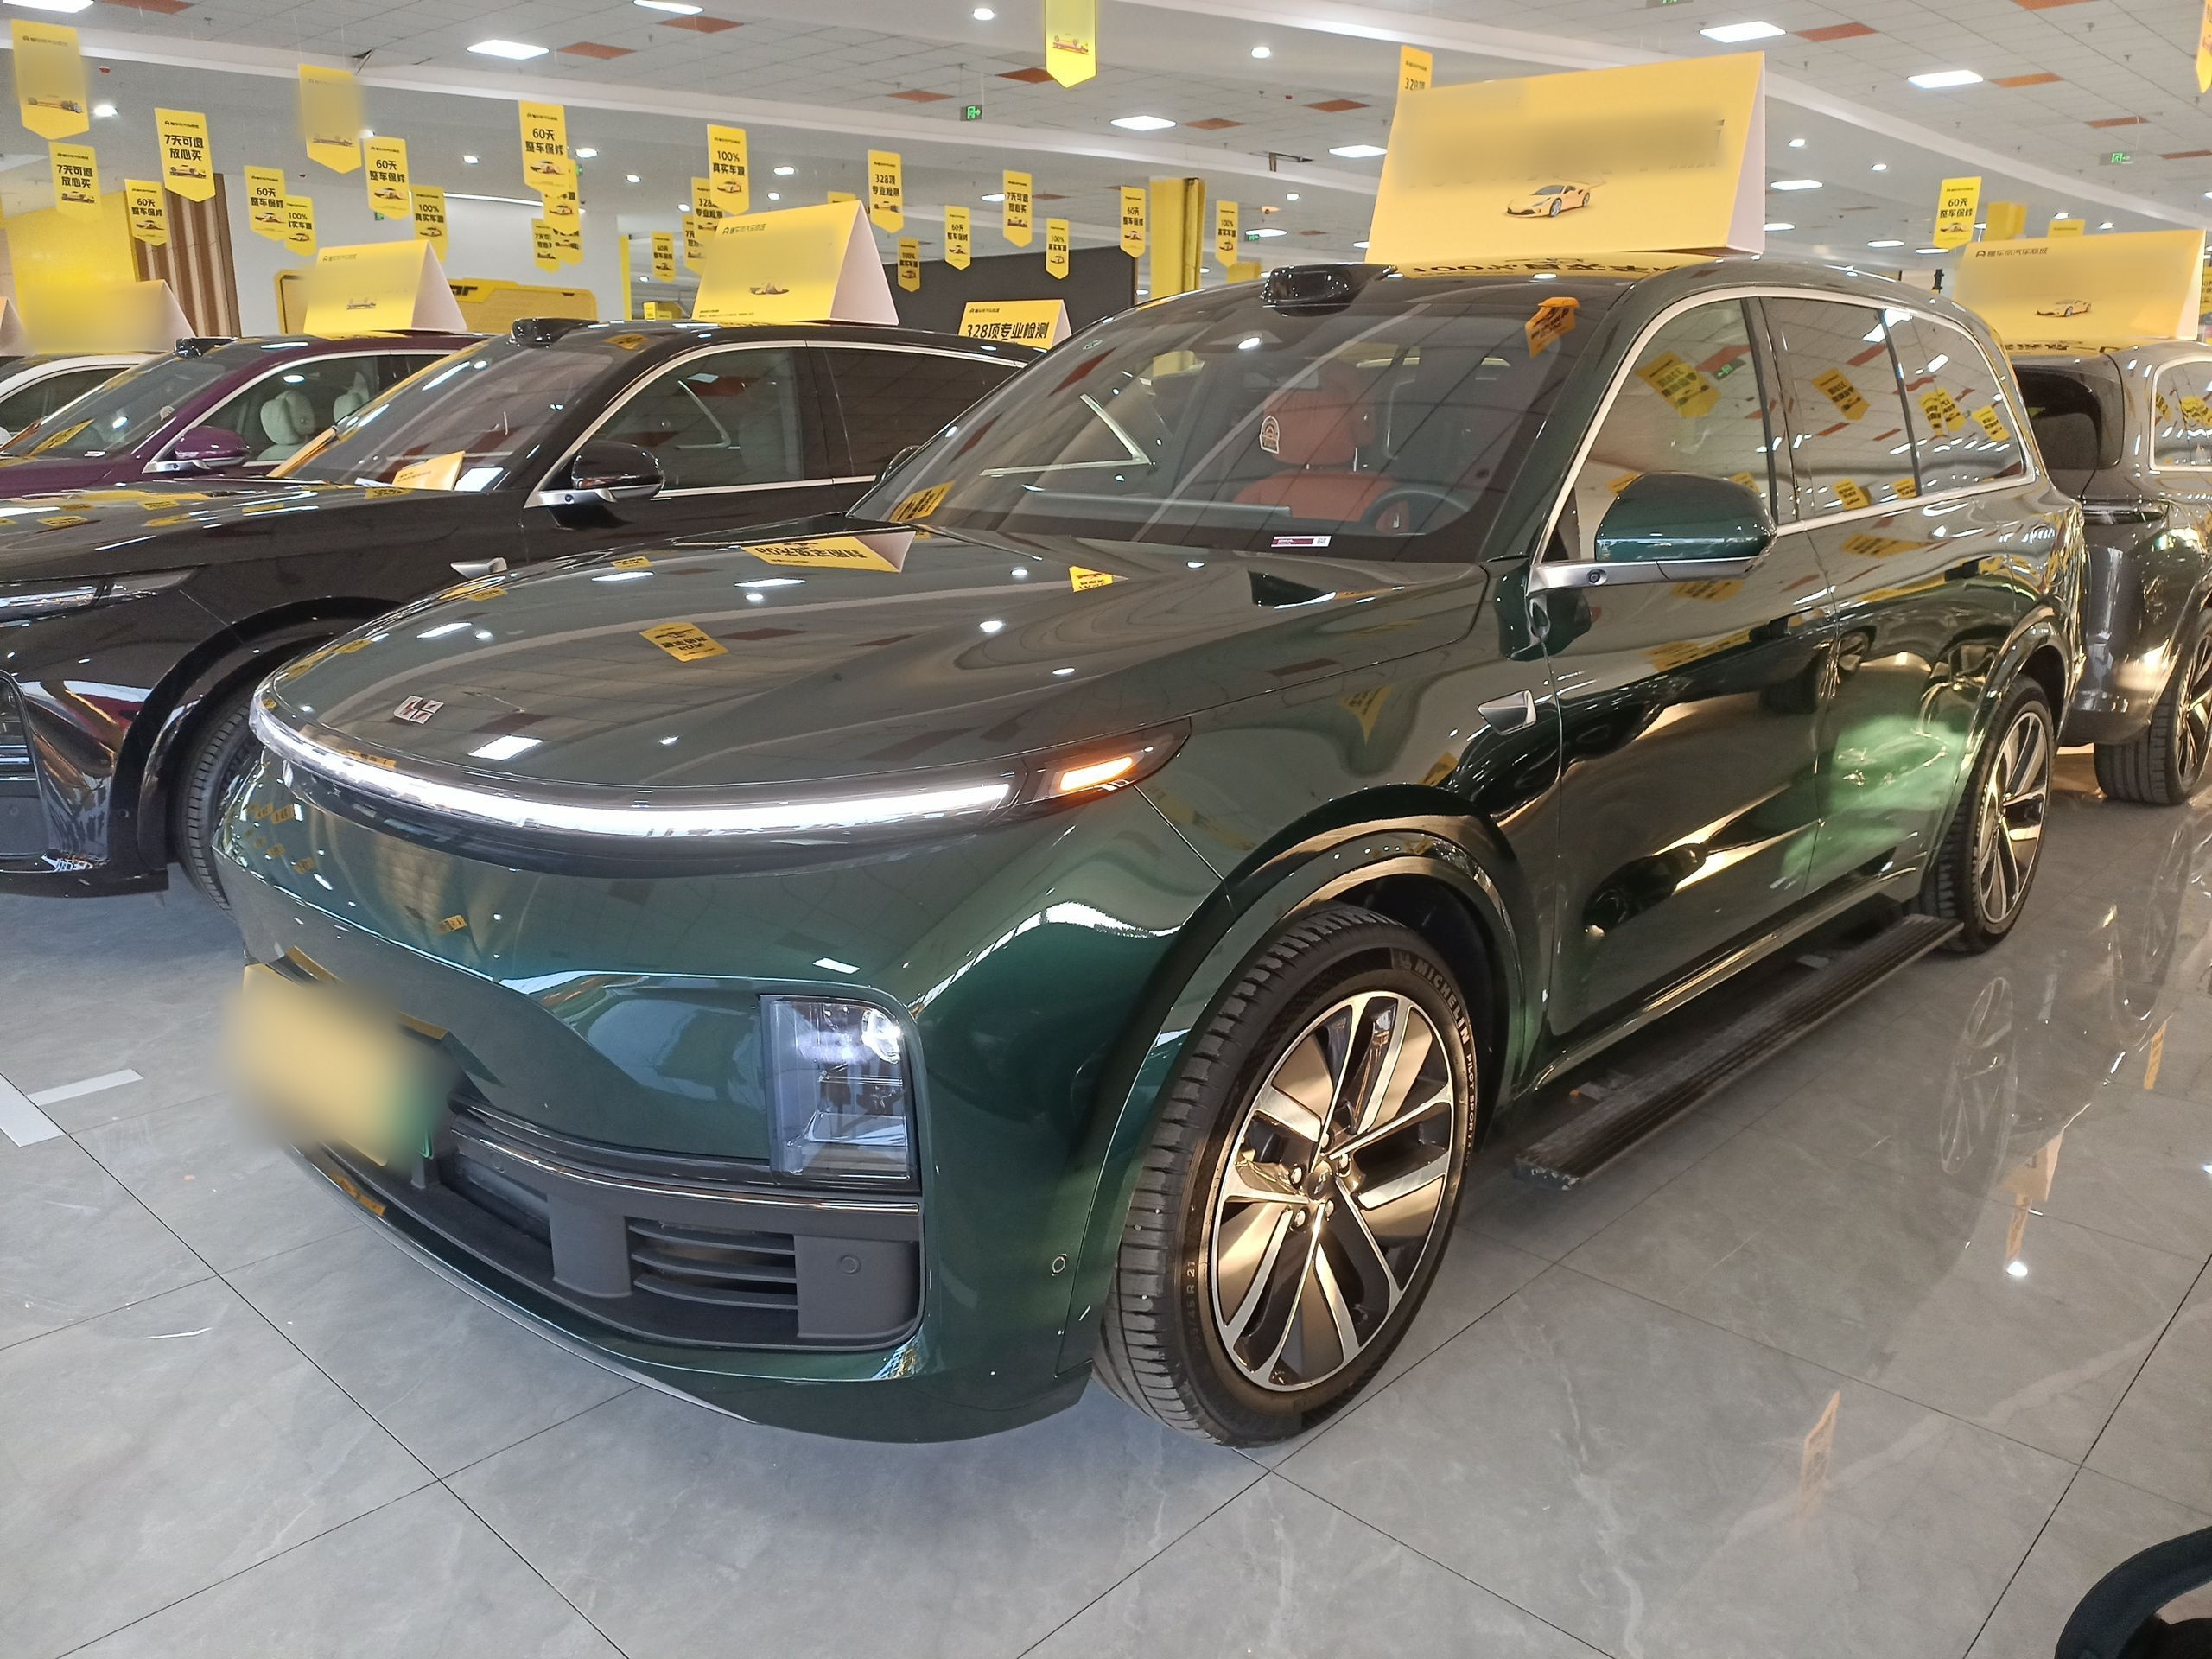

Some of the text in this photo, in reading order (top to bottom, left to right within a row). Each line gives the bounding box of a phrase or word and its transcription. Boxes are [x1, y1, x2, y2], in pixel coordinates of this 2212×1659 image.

[532, 128, 555, 140] 60天
[164, 135, 204, 148] 7天可退
[169, 148, 202, 161] 放心买
[525, 141, 563, 156] 整车保修
[717, 150, 740, 162] 100%
[57, 164, 93, 177] 7天可退
[376, 159, 397, 170] 60天
[713, 162, 745, 175] 真实车源
[61, 176, 91, 188] 放心买
[370, 170, 405, 183] 整车保修
[875, 174, 896, 185] 328项
[257, 188, 276, 197] 60天
[872, 185, 899, 197] 专业检测
[137, 198, 156, 207] 60天
[251, 197, 283, 208] 整车保修
[1007, 192, 1028, 203] 7天可退
[1948, 198, 1967, 207] 60天
[131, 207, 162, 216] 整车保修
[419, 204, 440, 213] 100%
[1127, 207, 1139, 216] 60天
[1940, 208, 1973, 218] 整车保修
[968, 321, 1050, 340] 328项专业检测
[1414, 957, 1469, 1044] MICHELIN
[1466, 1054, 1475, 1089] PILOT
[1187, 1262, 1195, 1277] 21
[1186, 1285, 1194, 1294] R
